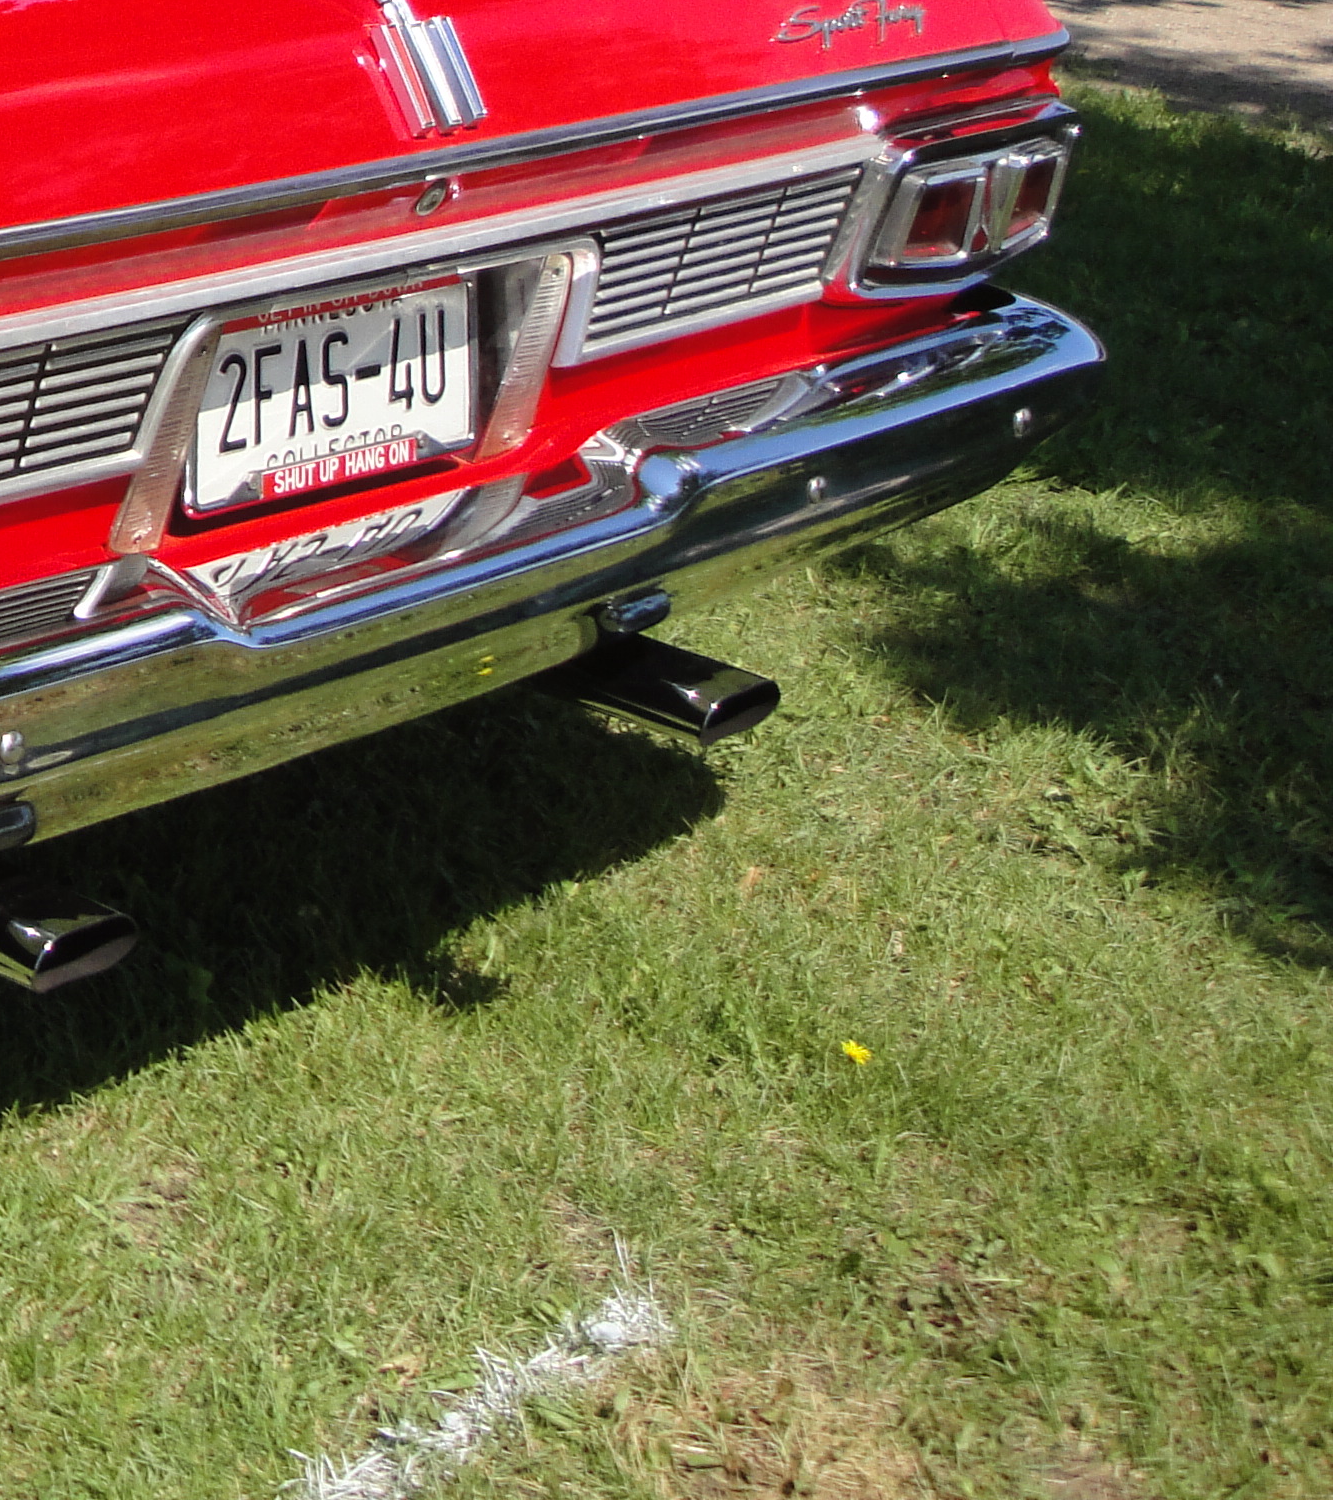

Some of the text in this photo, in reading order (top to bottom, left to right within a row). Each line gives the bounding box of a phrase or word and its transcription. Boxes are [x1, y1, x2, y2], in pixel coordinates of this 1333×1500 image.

[218, 309, 446, 454] 2FAS-4U
[274, 441, 409, 493] SHUT UP HANG ON
